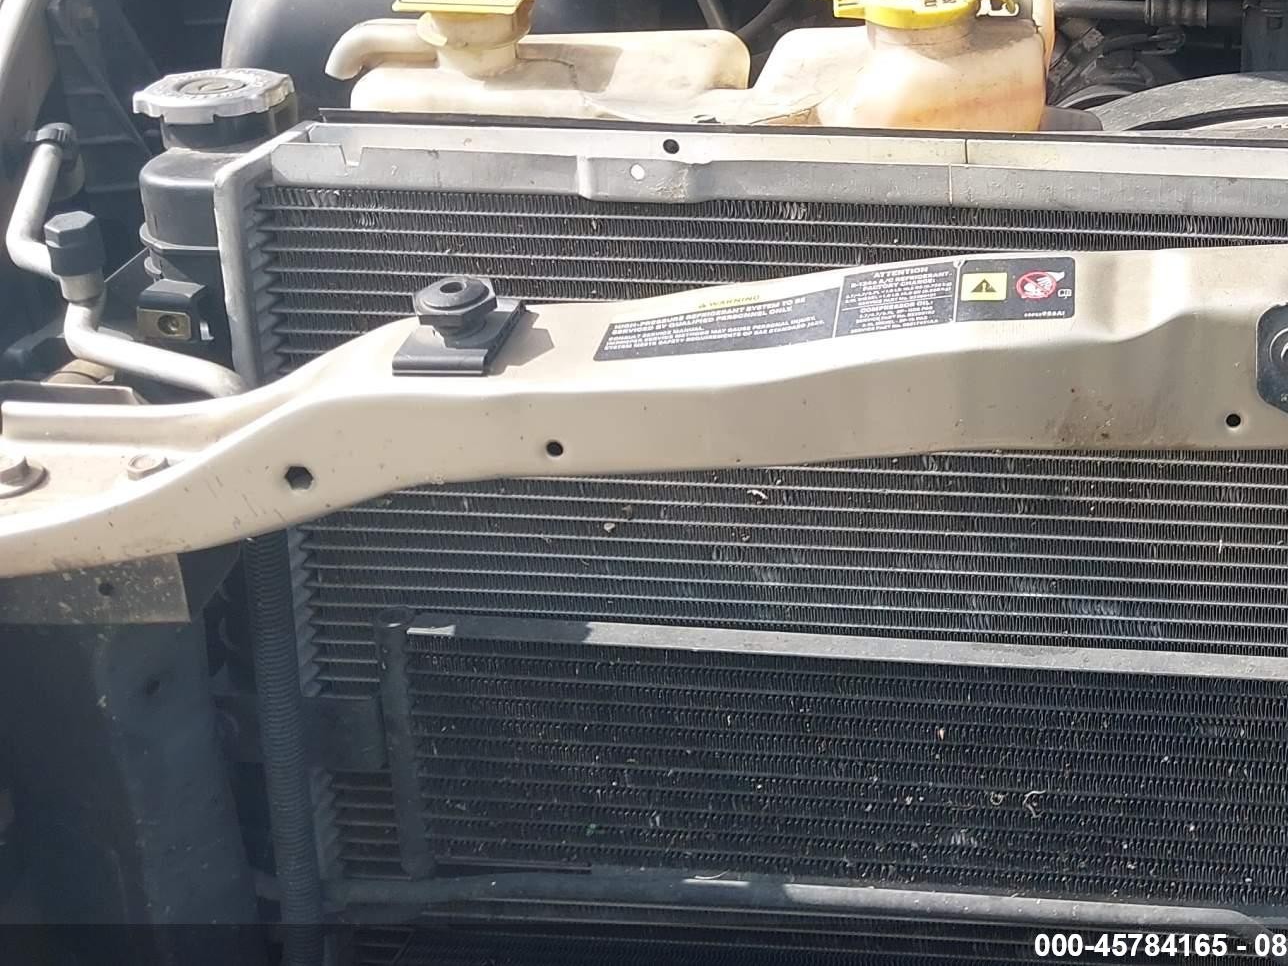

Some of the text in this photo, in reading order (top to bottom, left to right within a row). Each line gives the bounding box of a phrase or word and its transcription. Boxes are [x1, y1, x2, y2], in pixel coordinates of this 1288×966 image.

[873, 267, 929, 278] ATTENTION
[685, 307, 746, 320] REFRIGERANT
[746, 302, 780, 312] SYSTEM
[611, 326, 655, 335] SERVICED
[669, 317, 715, 328] QUALIFIED
[716, 311, 768, 322] PERSONNEL
